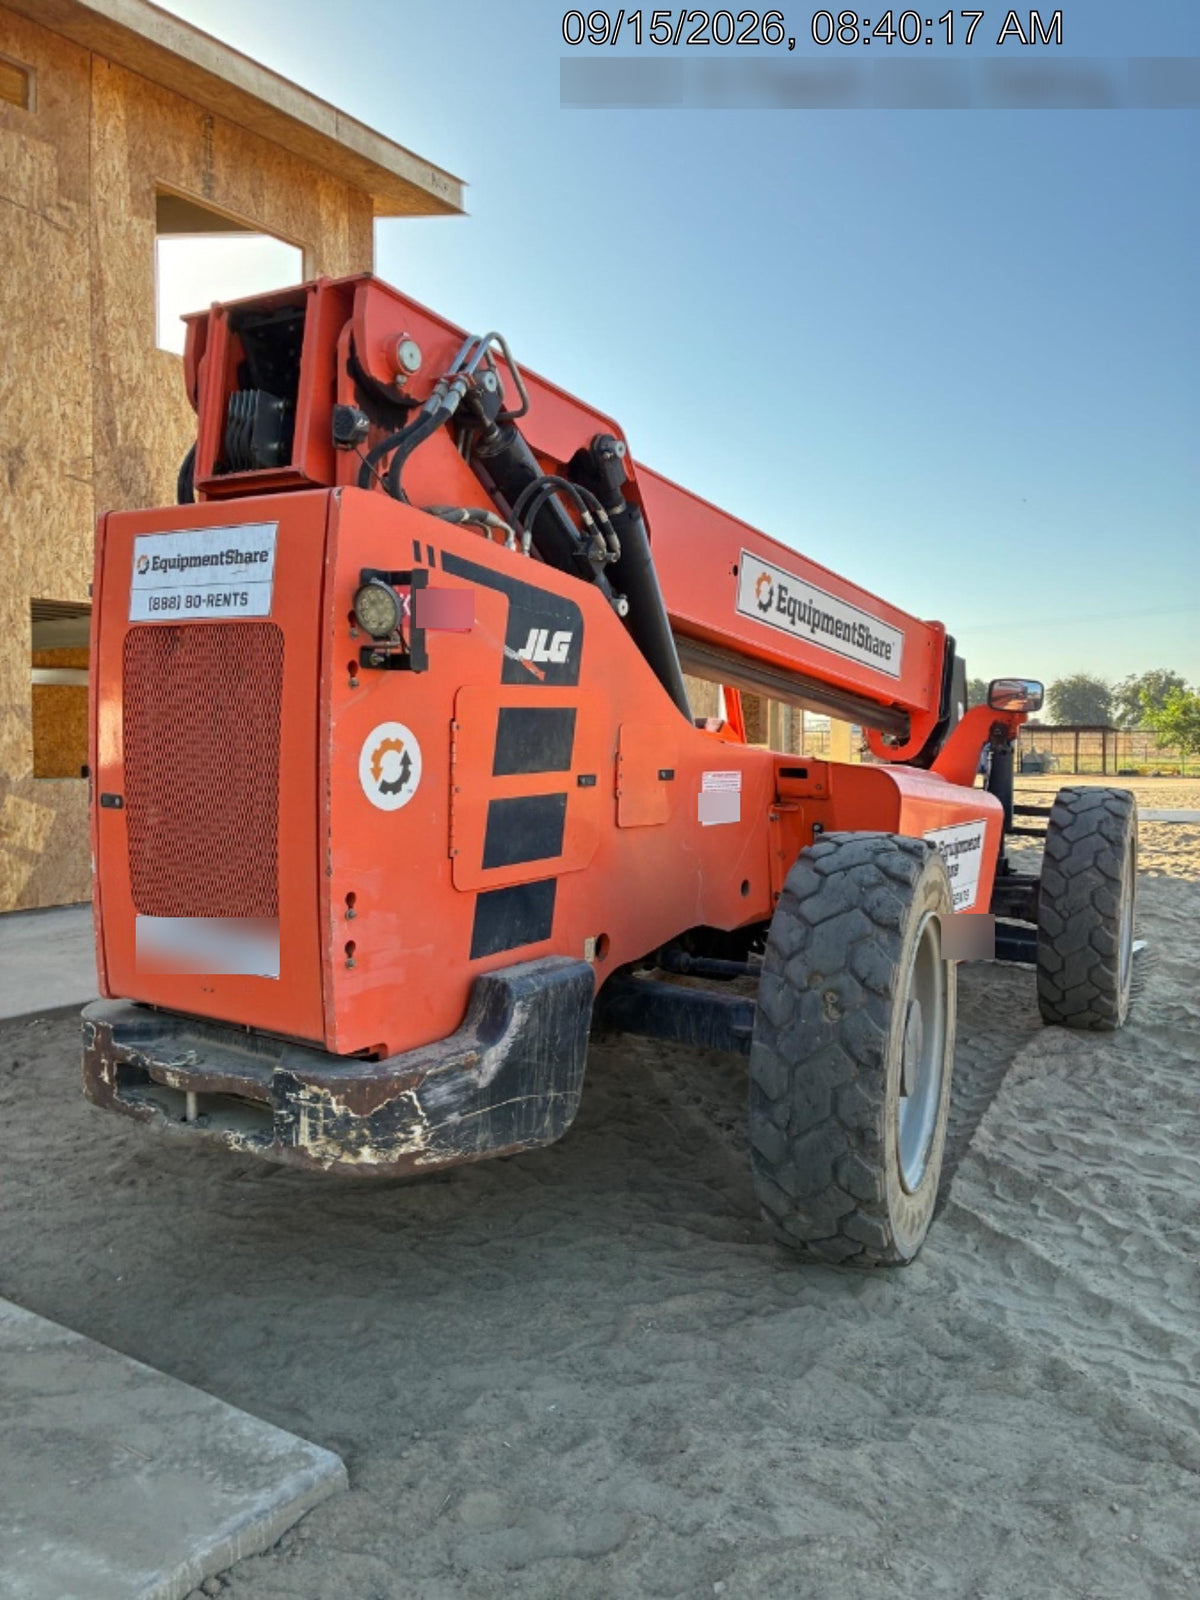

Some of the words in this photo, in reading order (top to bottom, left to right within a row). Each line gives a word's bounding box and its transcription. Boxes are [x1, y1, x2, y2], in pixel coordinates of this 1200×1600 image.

[151, 549, 268, 572] EquipmentShare
[149, 595, 180, 611] (888)
[776, 584, 892, 660] EquipmentShare
[518, 628, 573, 663] JLG
